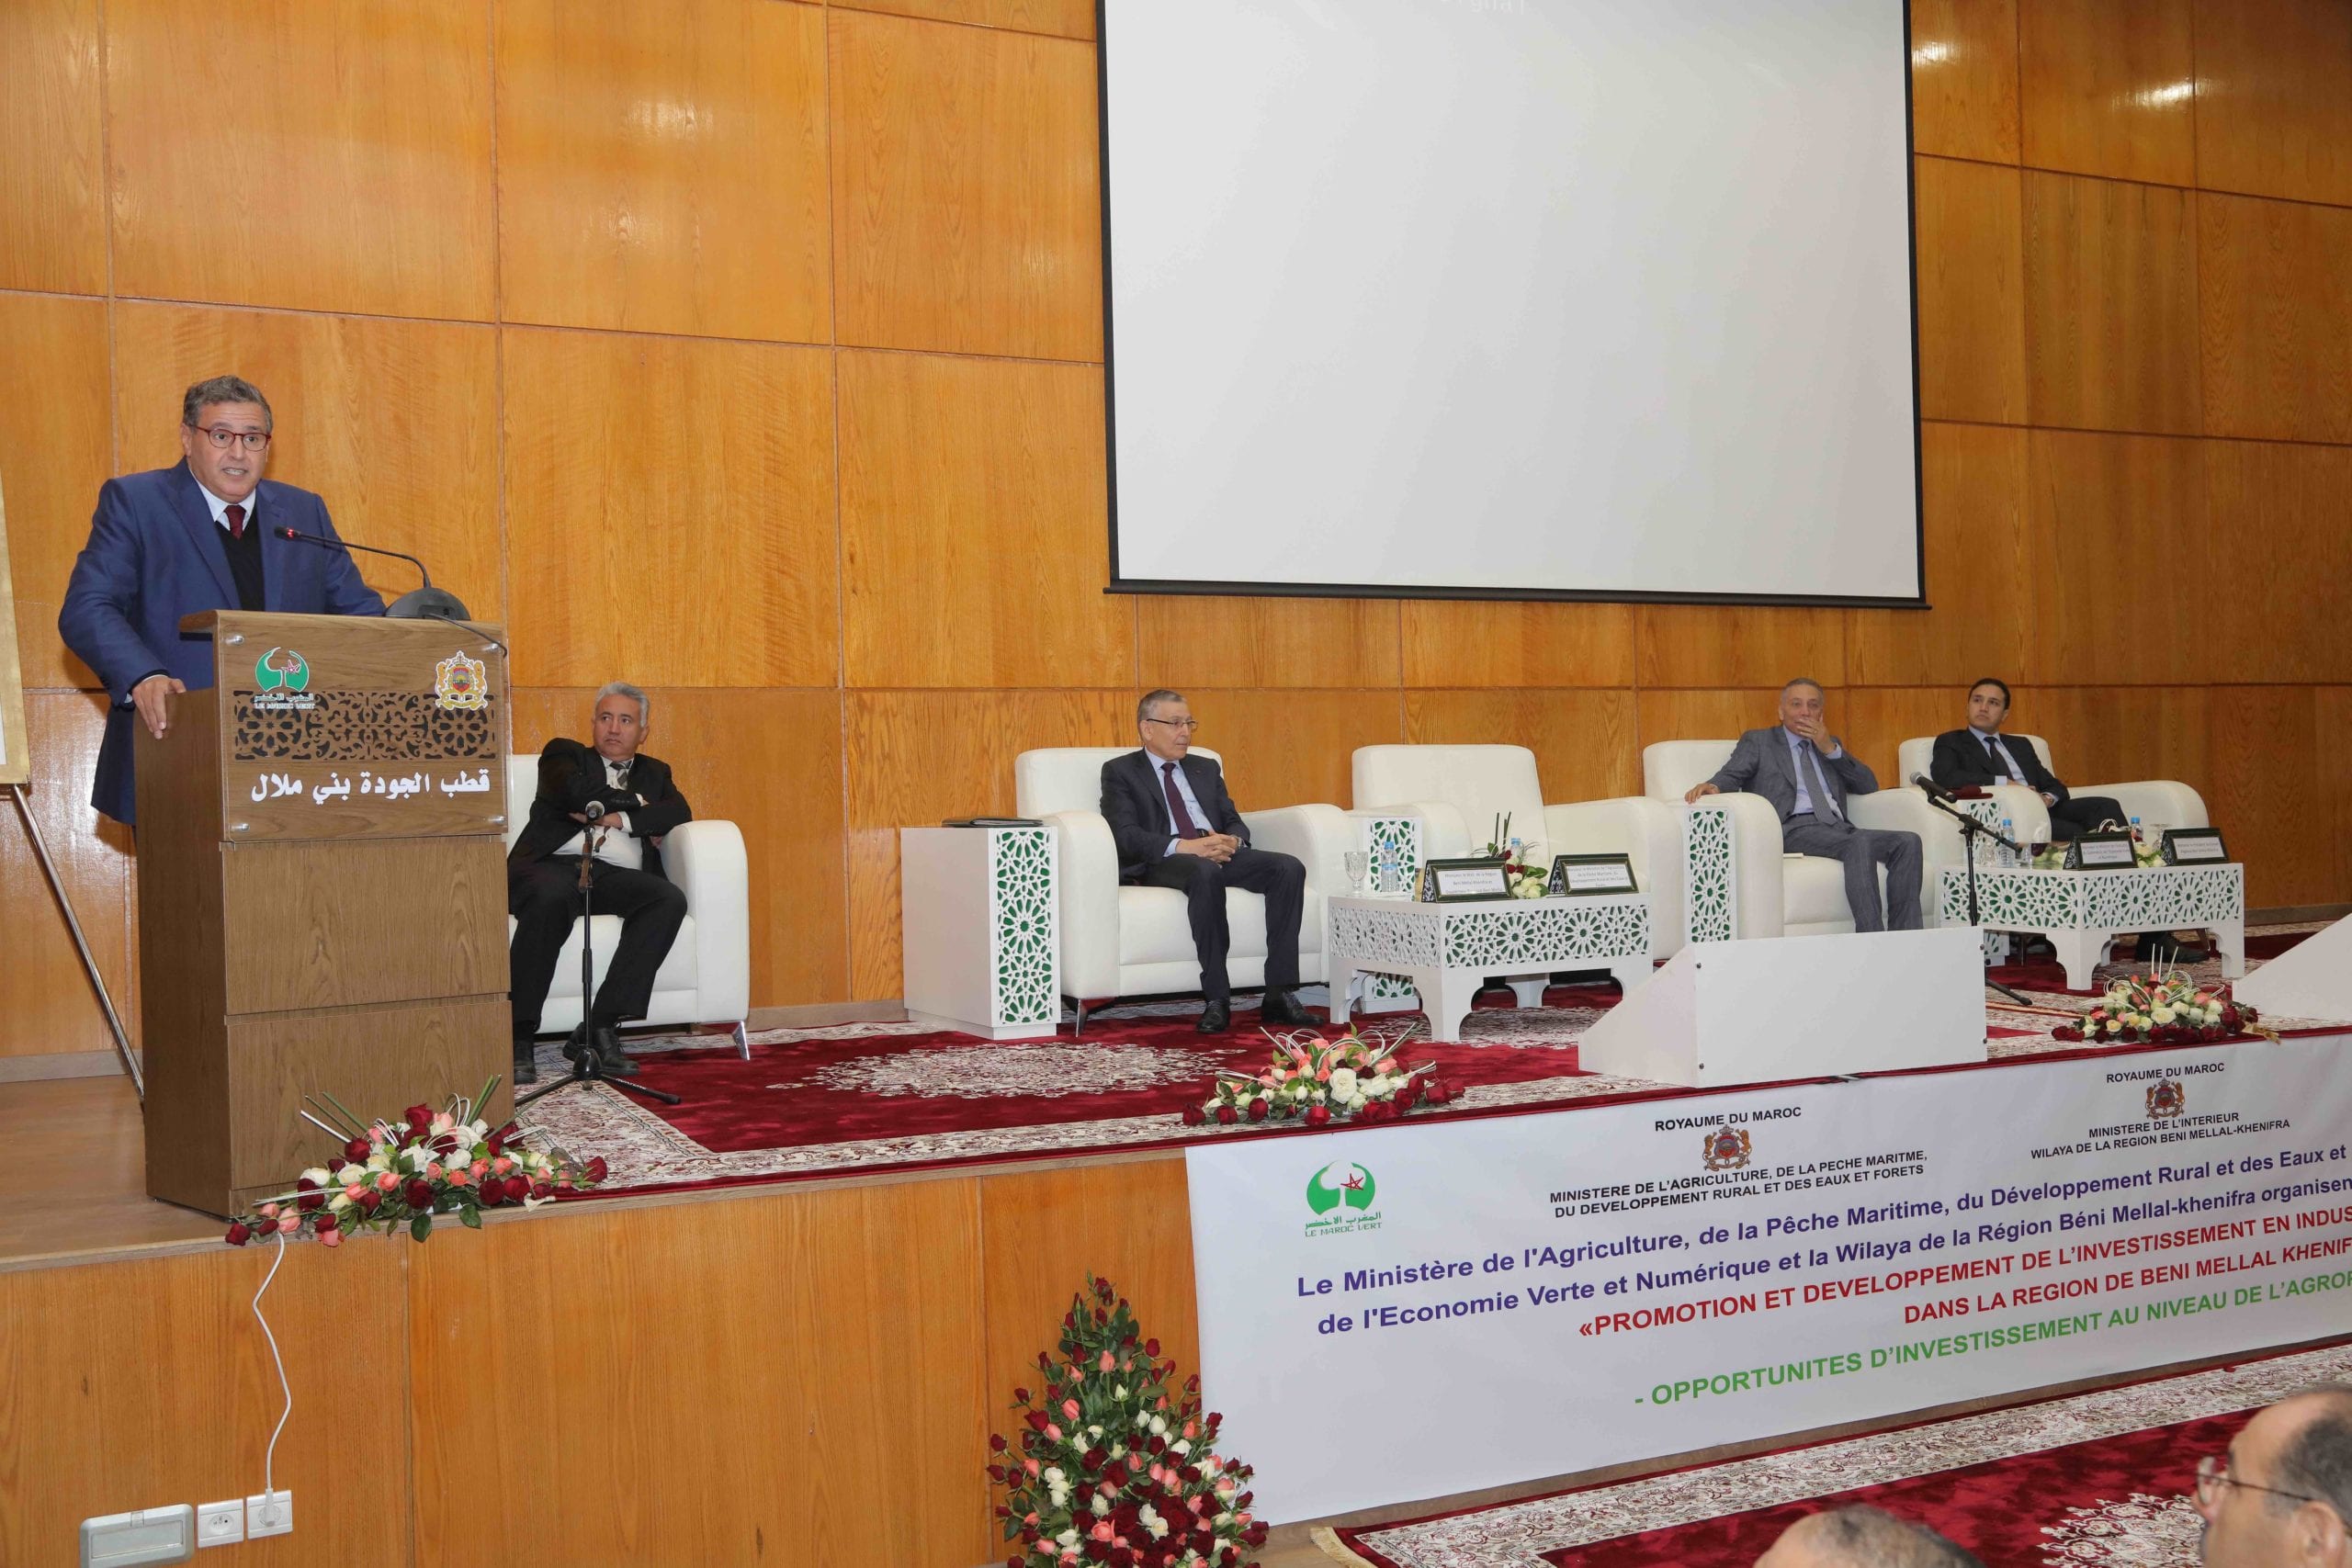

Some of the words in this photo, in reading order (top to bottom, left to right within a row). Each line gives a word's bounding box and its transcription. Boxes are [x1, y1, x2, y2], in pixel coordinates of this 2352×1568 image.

[251, 773, 303, 802] ملال
[312, 772, 351, 806] بني
[359, 771, 431, 800] الجودة
[440, 768, 491, 797] قطب
[2107, 1068, 2163, 1084] ROYAUME
[2165, 1067, 2181, 1077] DU
[2184, 1062, 2225, 1076] MAROC
[1655, 1115, 1724, 1131] ROYAUME
[1729, 1112, 1748, 1124] DU
[1752, 1107, 1802, 1122] MAROC
[2088, 1122, 2150, 1138] MINISTERE
[2154, 1121, 2169, 1131] DE
[2172, 1112, 2239, 1128] L'INTERIEUR
[2030, 1145, 2074, 1159] WILAYA
[2076, 1143, 2092, 1154] DE
[2095, 1140, 2110, 1151] LA
[2113, 1135, 2157, 1149] REGION
[2160, 1132, 2187, 1144] BENI
[2189, 1119, 2290, 1140] MELLAL-KHENIFRA
[1550, 1185, 1631, 1203] MINISTERE
[1635, 1182, 1654, 1193] DE
[1658, 1168, 1772, 1192] L'AGRICULTURE,
[1776, 1166, 1794, 1178] DE
[1799, 1164, 1816, 1175] LA
[1819, 1157, 1862, 1172] PECHE
[1866, 1150, 1928, 1166] MARITME,
[1555, 1206, 1575, 1218] DU
[1580, 1190, 1709, 1215] DEVELOPPEMENT
[1713, 1185, 1760, 1200] RURAL
[1764, 1182, 1781, 1193] ET
[1785, 1179, 1812, 1191] DES
[1815, 1175, 1850, 1188] EAUX
[1854, 1171, 1870, 1182] ET
[1873, 1164, 1924, 1179] FORETS
[1297, 1277, 1333, 1297] Le
[1344, 1260, 1474, 1292] Ministère
[1483, 1253, 1515, 1273] de
[1524, 1235, 1690, 1269] l'Agriculture,
[1700, 1226, 1729, 1245] de
[1738, 1223, 1758, 1240] la
[1767, 1213, 1839, 1236] Pêche
[1848, 1201, 1950, 1226] Maritime,
[1957, 1193, 1984, 1211] du
[1991, 1169, 2152, 1206] Développement
[2158, 1162, 2210, 1183] Rural
[2216, 1160, 2233, 1176] et
[2240, 1154, 2274, 1173] des
[2279, 1151, 2324, 1168] Eaux
[2330, 1145, 2346, 1159] et
[1305, 1229, 1317, 1237] LE
[1320, 1225, 1354, 1235] MAROC
[1358, 1222, 1383, 1231] VERT
[1345, 1211, 1382, 1225] المغرب
[1317, 1314, 1353, 1335] de
[1363, 1292, 1519, 1329] l'Economie
[1527, 1282, 1595, 1305] Verte
[1603, 1276, 1628, 1295] et
[1636, 1259, 1770, 1291] Numérique
[1779, 1252, 1801, 1270] et
[1809, 1248, 1828, 1267] la
[1836, 1240, 1911, 1262] Wilaya
[1918, 1234, 1945, 1251] de
[1953, 1230, 1971, 1247] la
[1978, 1220, 2052, 1243] Région
[2060, 1209, 2105, 1231] Béni
[2113, 1190, 2256, 1224] Mellal-khenifra
[2261, 1178, 2352, 1203] organisen
[1579, 1293, 1756, 1337] «PROMOTION
[1765, 1288, 1795, 1309] ET
[1804, 1256, 2015, 1303] DEVELOPPEMENT
[2022, 1250, 2051, 1270] DE
[2059, 1220, 2256, 1265] L'INVESTISSEMENT
[2263, 1215, 2290, 1234] EN
[2296, 1205, 2352, 1229] INDUS
[1905, 1297, 1970, 1324] DANS
[1977, 1292, 2007, 1313] LA
[2013, 1278, 2098, 1306] REGION
[2106, 1271, 2133, 1292] DE
[2141, 1263, 2189, 1285] BENI
[2197, 1250, 2277, 1277] MELLAL
[2282, 1237, 2352, 1263] KHENIF
[1651, 1352, 1862, 1405] OPPORTUNITES
[1871, 1313, 2102, 1369] D'INVESTISSEMENT
[2108, 1306, 2140, 1327] AU
[2147, 1292, 2227, 1321] NIVEAU
[2234, 1285, 2262, 1306] DE
